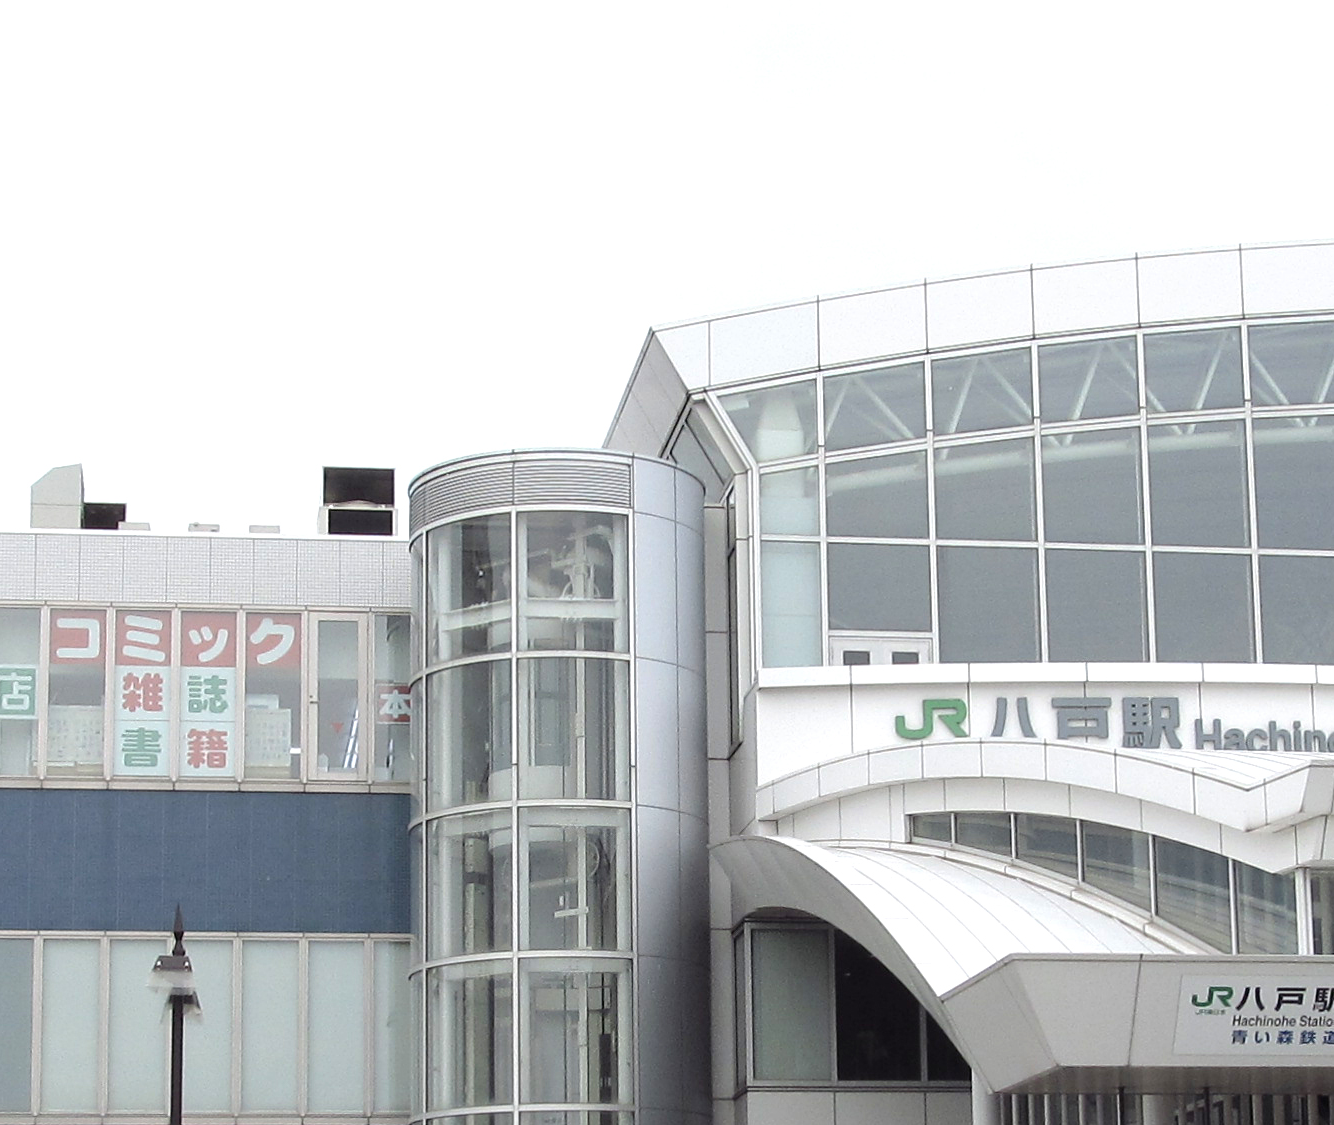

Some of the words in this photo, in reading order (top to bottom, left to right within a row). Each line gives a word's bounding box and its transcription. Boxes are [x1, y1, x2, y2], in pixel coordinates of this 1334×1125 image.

[56, 615, 296, 665] コミック
[122, 672, 228, 714] 雑誌
[379, 690, 410, 718] 本
[895, 699, 969, 739] JR
[991, 697, 1183, 749] 八戸駅
[121, 727, 228, 769] 書籍
[1191, 986, 1234, 1007] JR
[1232, 1015, 1297, 1027] Hachinohe
